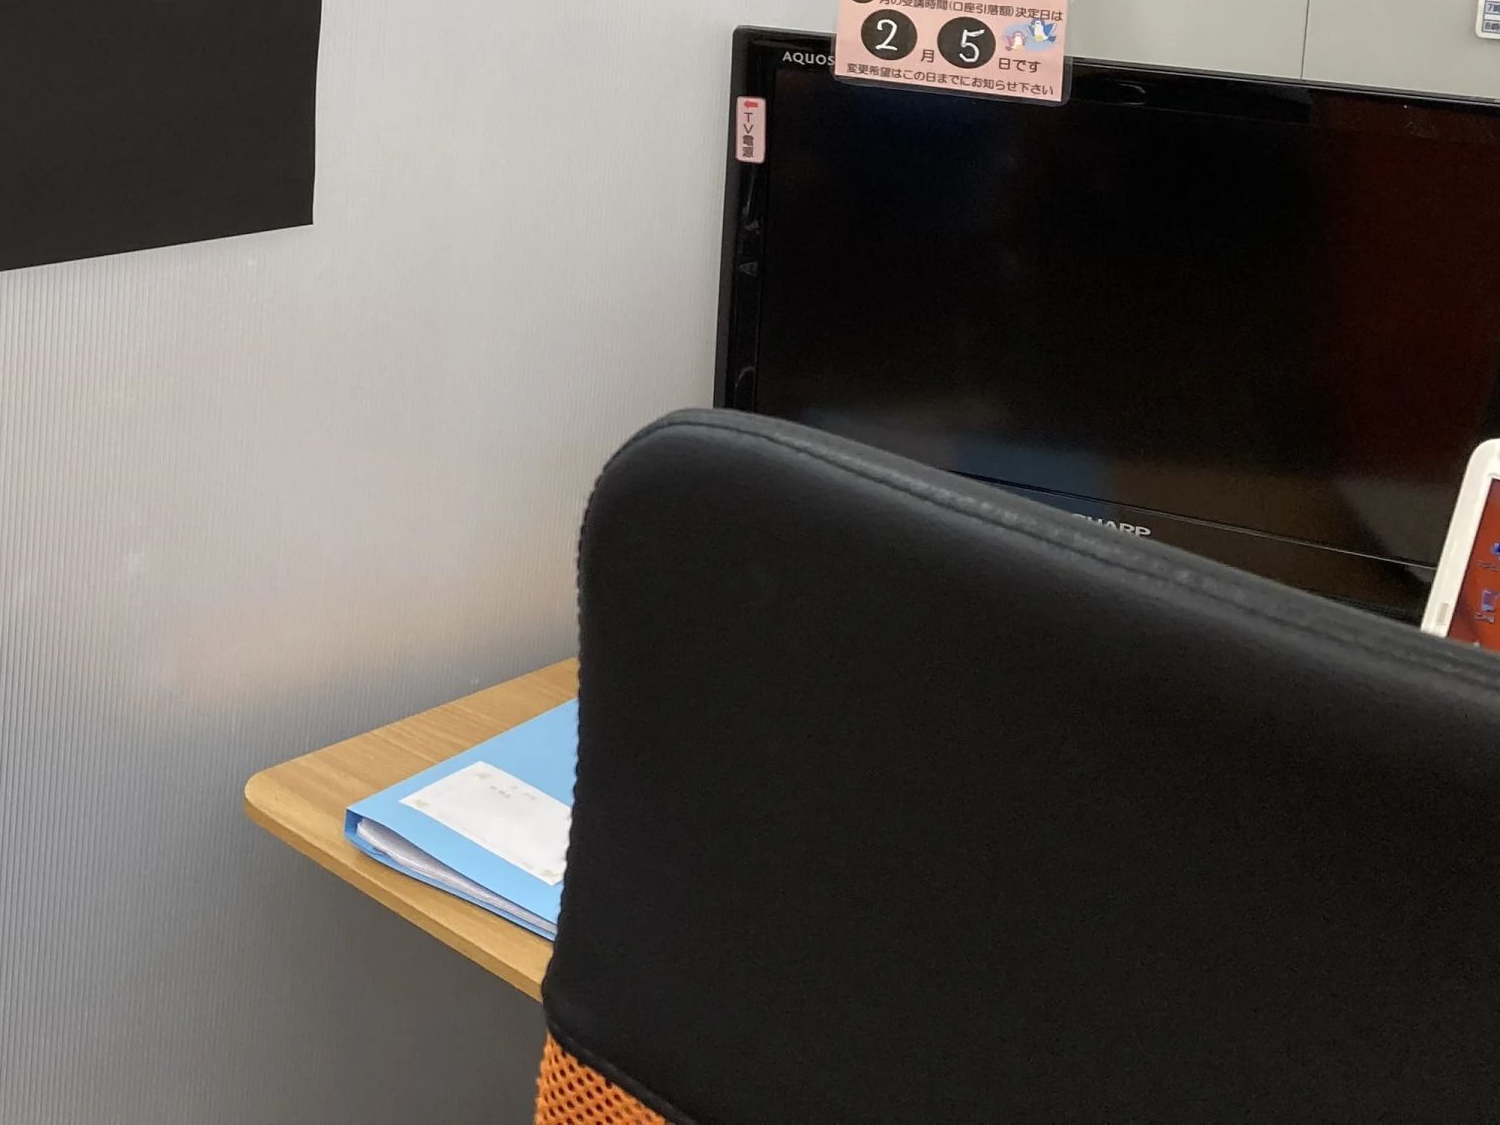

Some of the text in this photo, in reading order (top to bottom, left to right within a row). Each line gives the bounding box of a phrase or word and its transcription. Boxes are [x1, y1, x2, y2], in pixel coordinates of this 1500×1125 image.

[782, 51, 836, 65] AQUOS
[875, 19, 1041, 73] 2 月 5 日です
[846, 63, 1054, 96] 変更希望はこの日までにお知らせ下さい
